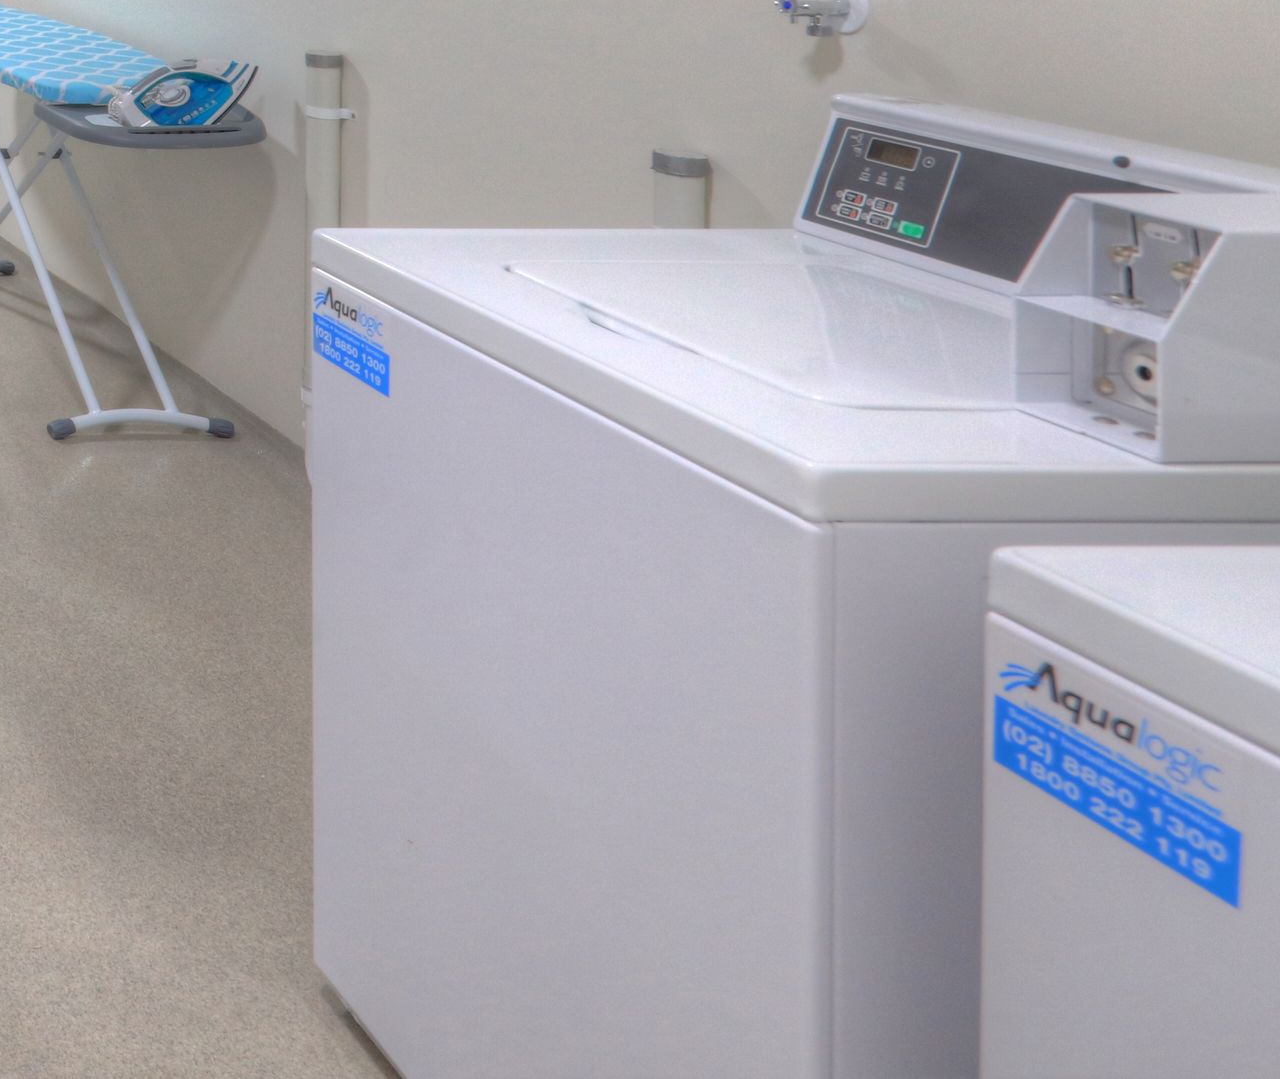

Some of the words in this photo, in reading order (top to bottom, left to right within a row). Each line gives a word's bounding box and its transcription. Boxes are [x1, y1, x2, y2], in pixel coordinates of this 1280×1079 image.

[315, 324, 332, 345] (02)
[362, 353, 386, 375] 1300
[320, 342, 341, 362] 1800
[343, 356, 360, 374] 222
[364, 370, 381, 386] 119
[1028, 660, 1224, 793] Aqualogic
[1003, 719, 1052, 764] (02)
[1062, 754, 1137, 809] 8850
[1150, 807, 1228, 863] 1300
[1016, 753, 1080, 801] 1800
[1089, 796, 1144, 841] 222
[1156, 837, 1213, 880] 119
